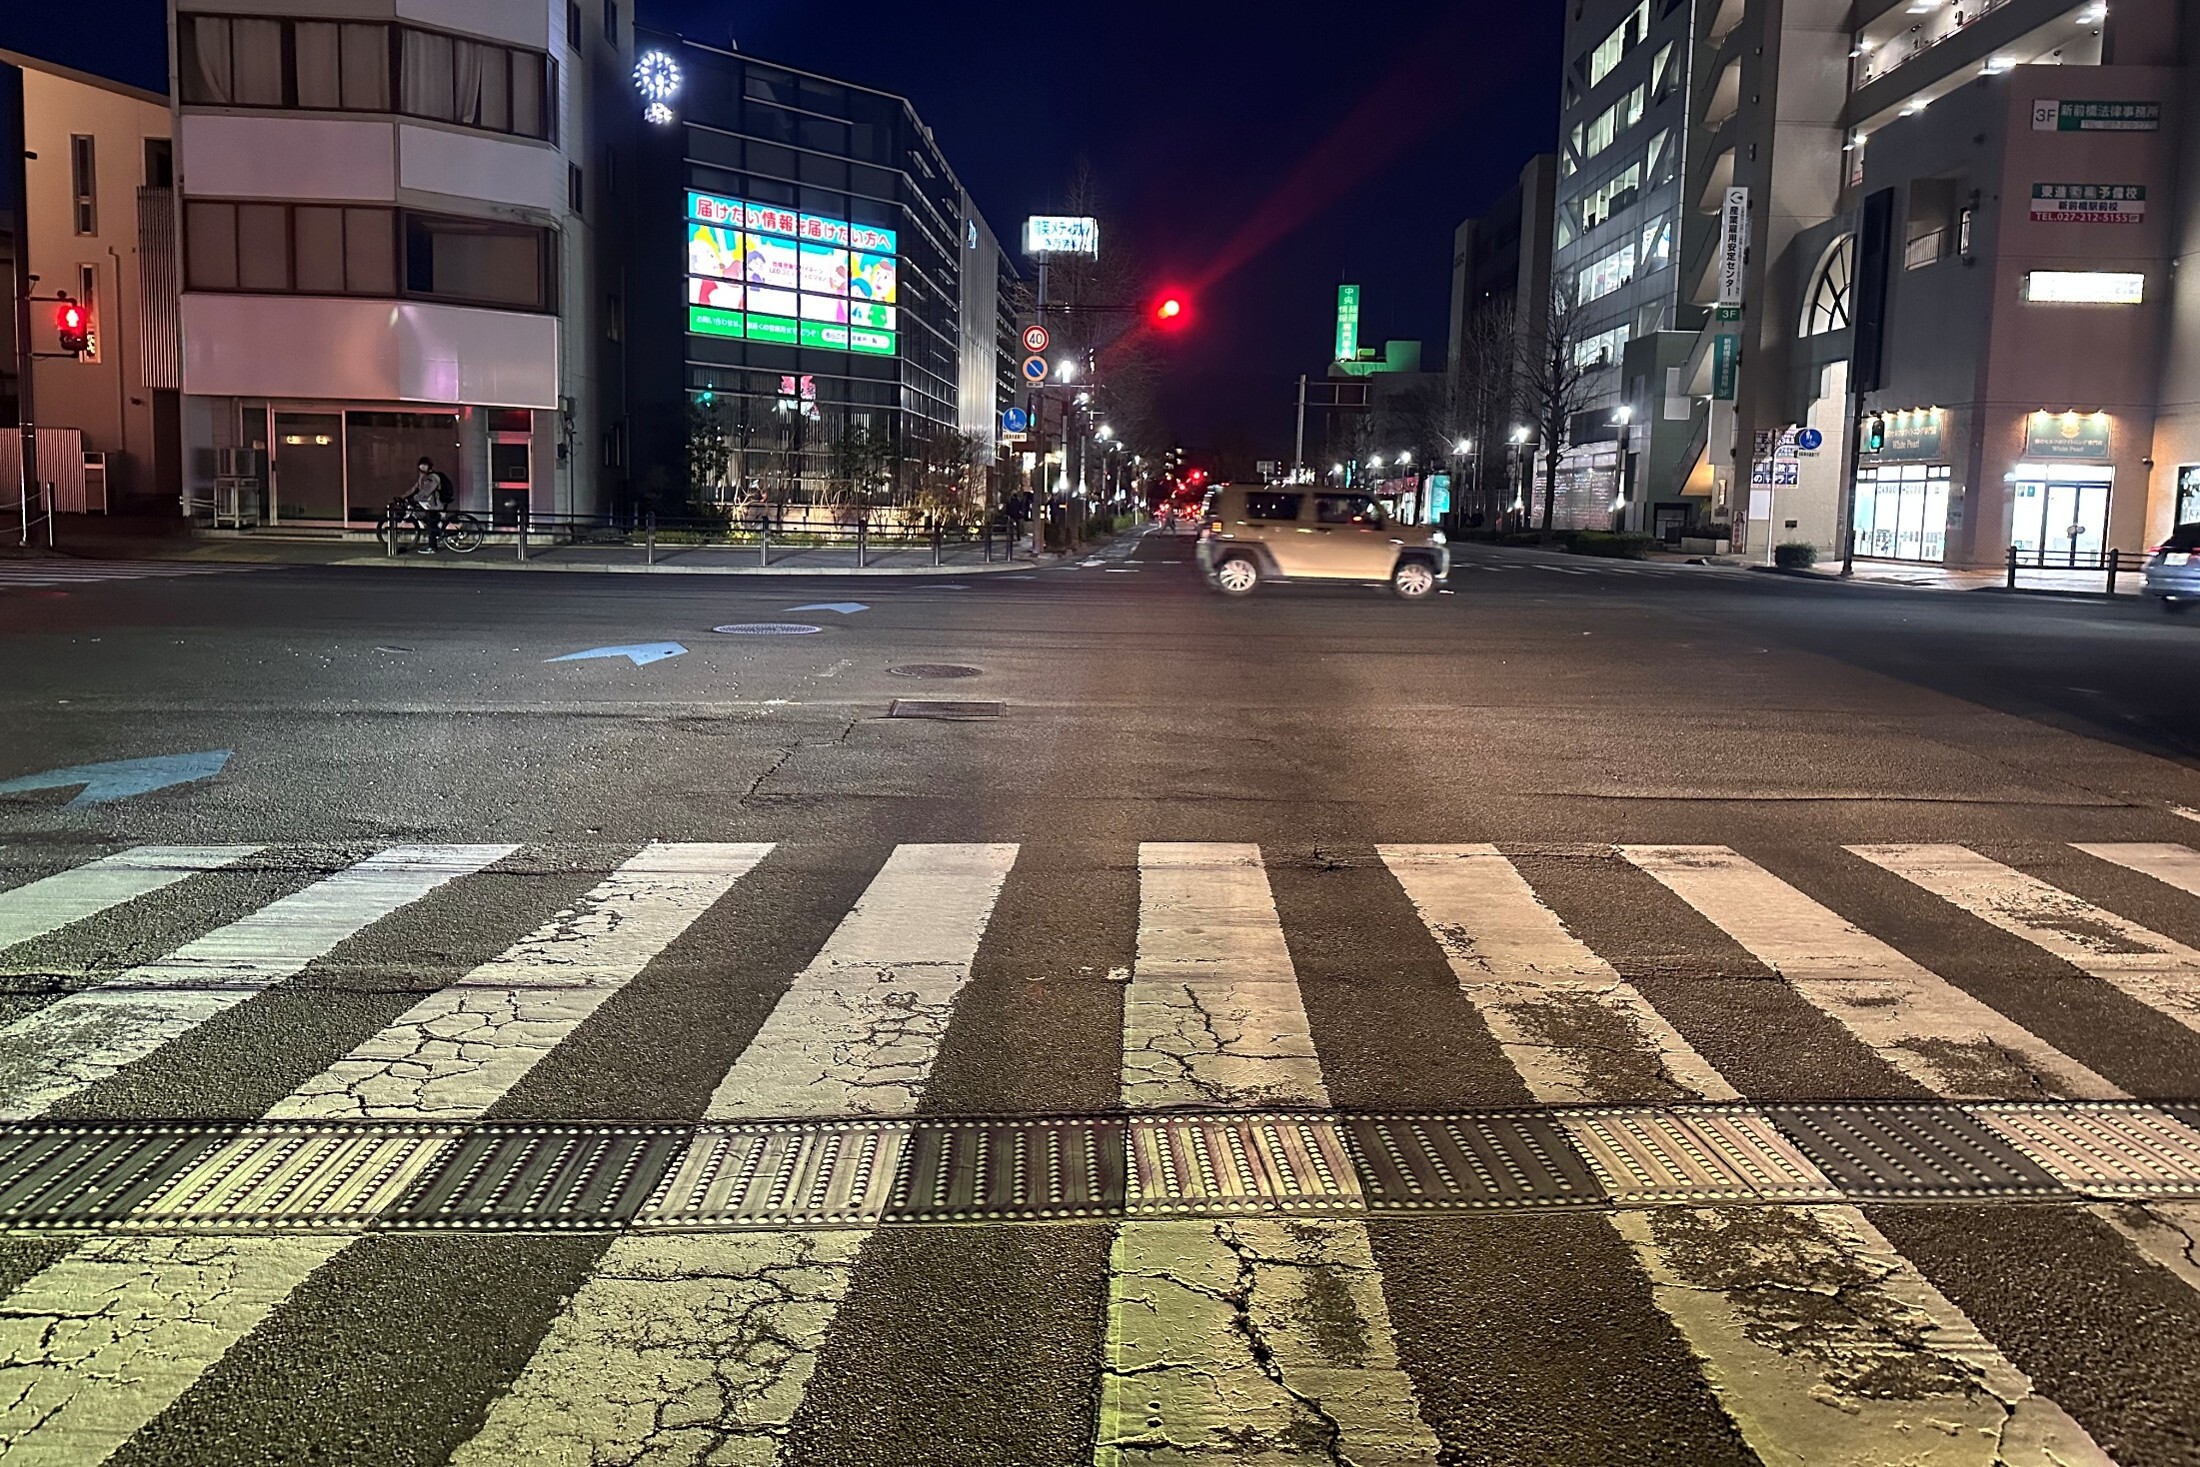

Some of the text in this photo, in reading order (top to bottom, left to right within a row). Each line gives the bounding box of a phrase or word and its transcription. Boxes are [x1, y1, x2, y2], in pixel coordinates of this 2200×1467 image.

[2035, 108, 2056, 122] 3F
[2060, 104, 2158, 118] 新前橋法律事務所
[2058, 201, 2118, 211] 新前橋駅前校
[2036, 212, 2128, 221] TEL.027-212-5155
[697, 198, 891, 249] 届けたい情報を届けたい方へ
[1725, 206, 1739, 297] 産業雇用安定センター
[1721, 309, 1737, 319] 3F
[1029, 333, 1043, 345] 40
